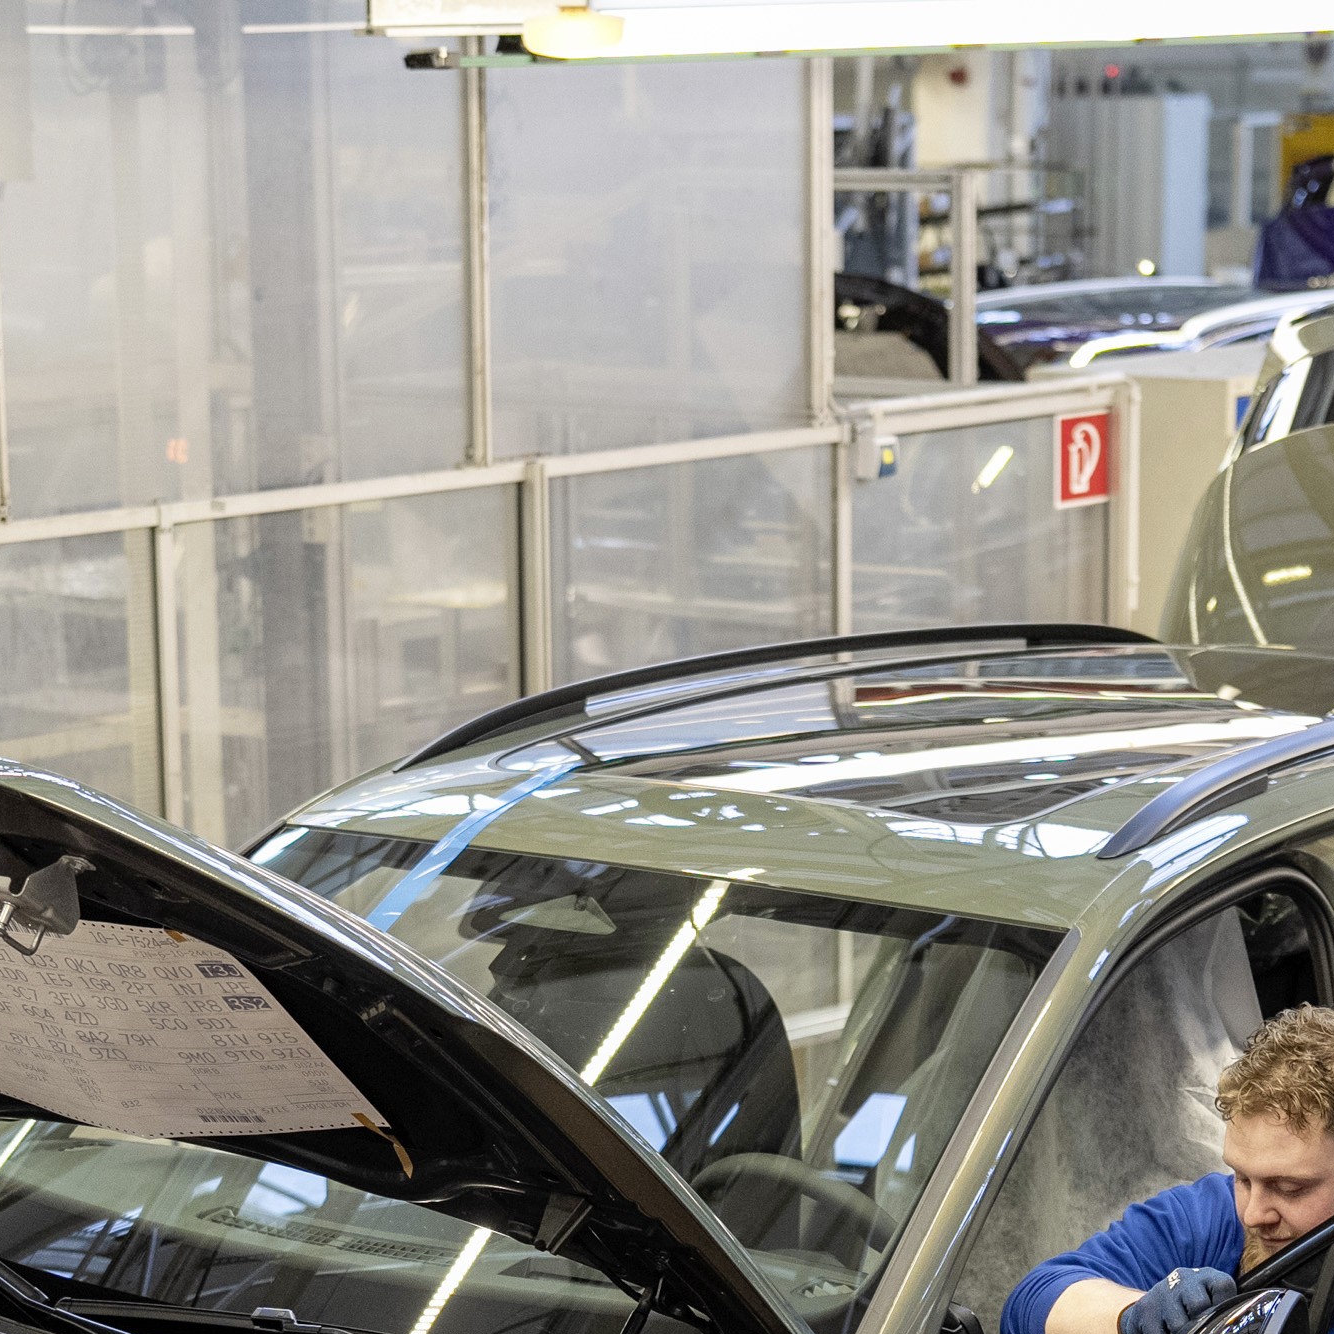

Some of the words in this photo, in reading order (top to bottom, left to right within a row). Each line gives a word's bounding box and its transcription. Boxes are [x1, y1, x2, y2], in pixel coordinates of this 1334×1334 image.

[64, 957, 100, 975] QK1
[107, 962, 147, 979] QR8
[203, 965, 241, 978] T3J
[36, 972, 73, 988] 1E5
[78, 976, 116, 992] 1G8
[121, 980, 158, 996] 2PT
[168, 982, 204, 996] 1N7
[214, 981, 256, 995] 1PE
[7, 983, 38, 1001] 3C7
[48, 990, 87, 1008] 3FU
[91, 995, 129, 1012] 3GD
[135, 999, 178, 1014] 5KR
[183, 999, 224, 1014] 1R8
[228, 998, 268, 1011] 3S2
[64, 1010, 99, 1027] 4ZD
[196, 1017, 238, 1031] 5D1
[33, 1020, 67, 1039] 7UY
[75, 1030, 116, 1045] 8A2
[118, 1033, 159, 1047] 79H
[9, 1032, 42, 1049] 8Y1
[88, 1046, 130, 1062] 9ZQ
